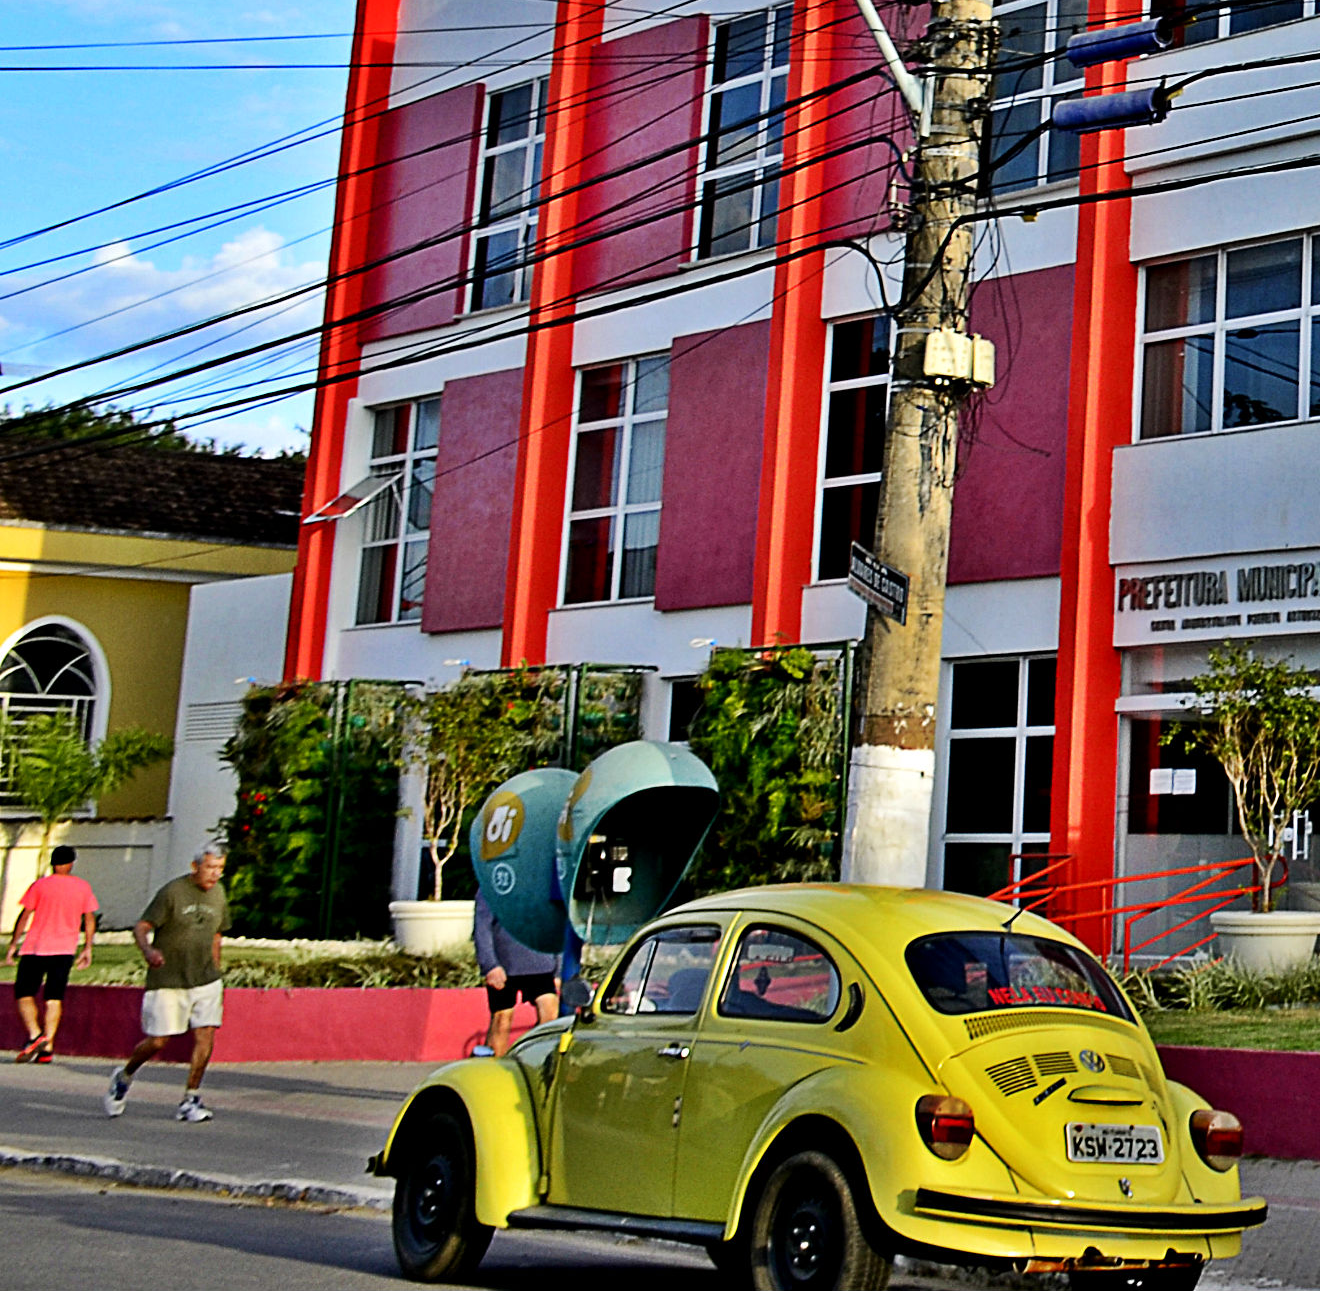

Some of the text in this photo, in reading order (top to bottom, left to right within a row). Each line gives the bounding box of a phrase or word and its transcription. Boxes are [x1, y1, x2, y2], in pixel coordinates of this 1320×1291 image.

[1118, 570, 1229, 612] PREFEITURA
[987, 986, 1035, 1005] NELA
[1032, 986, 1057, 1004] EU
